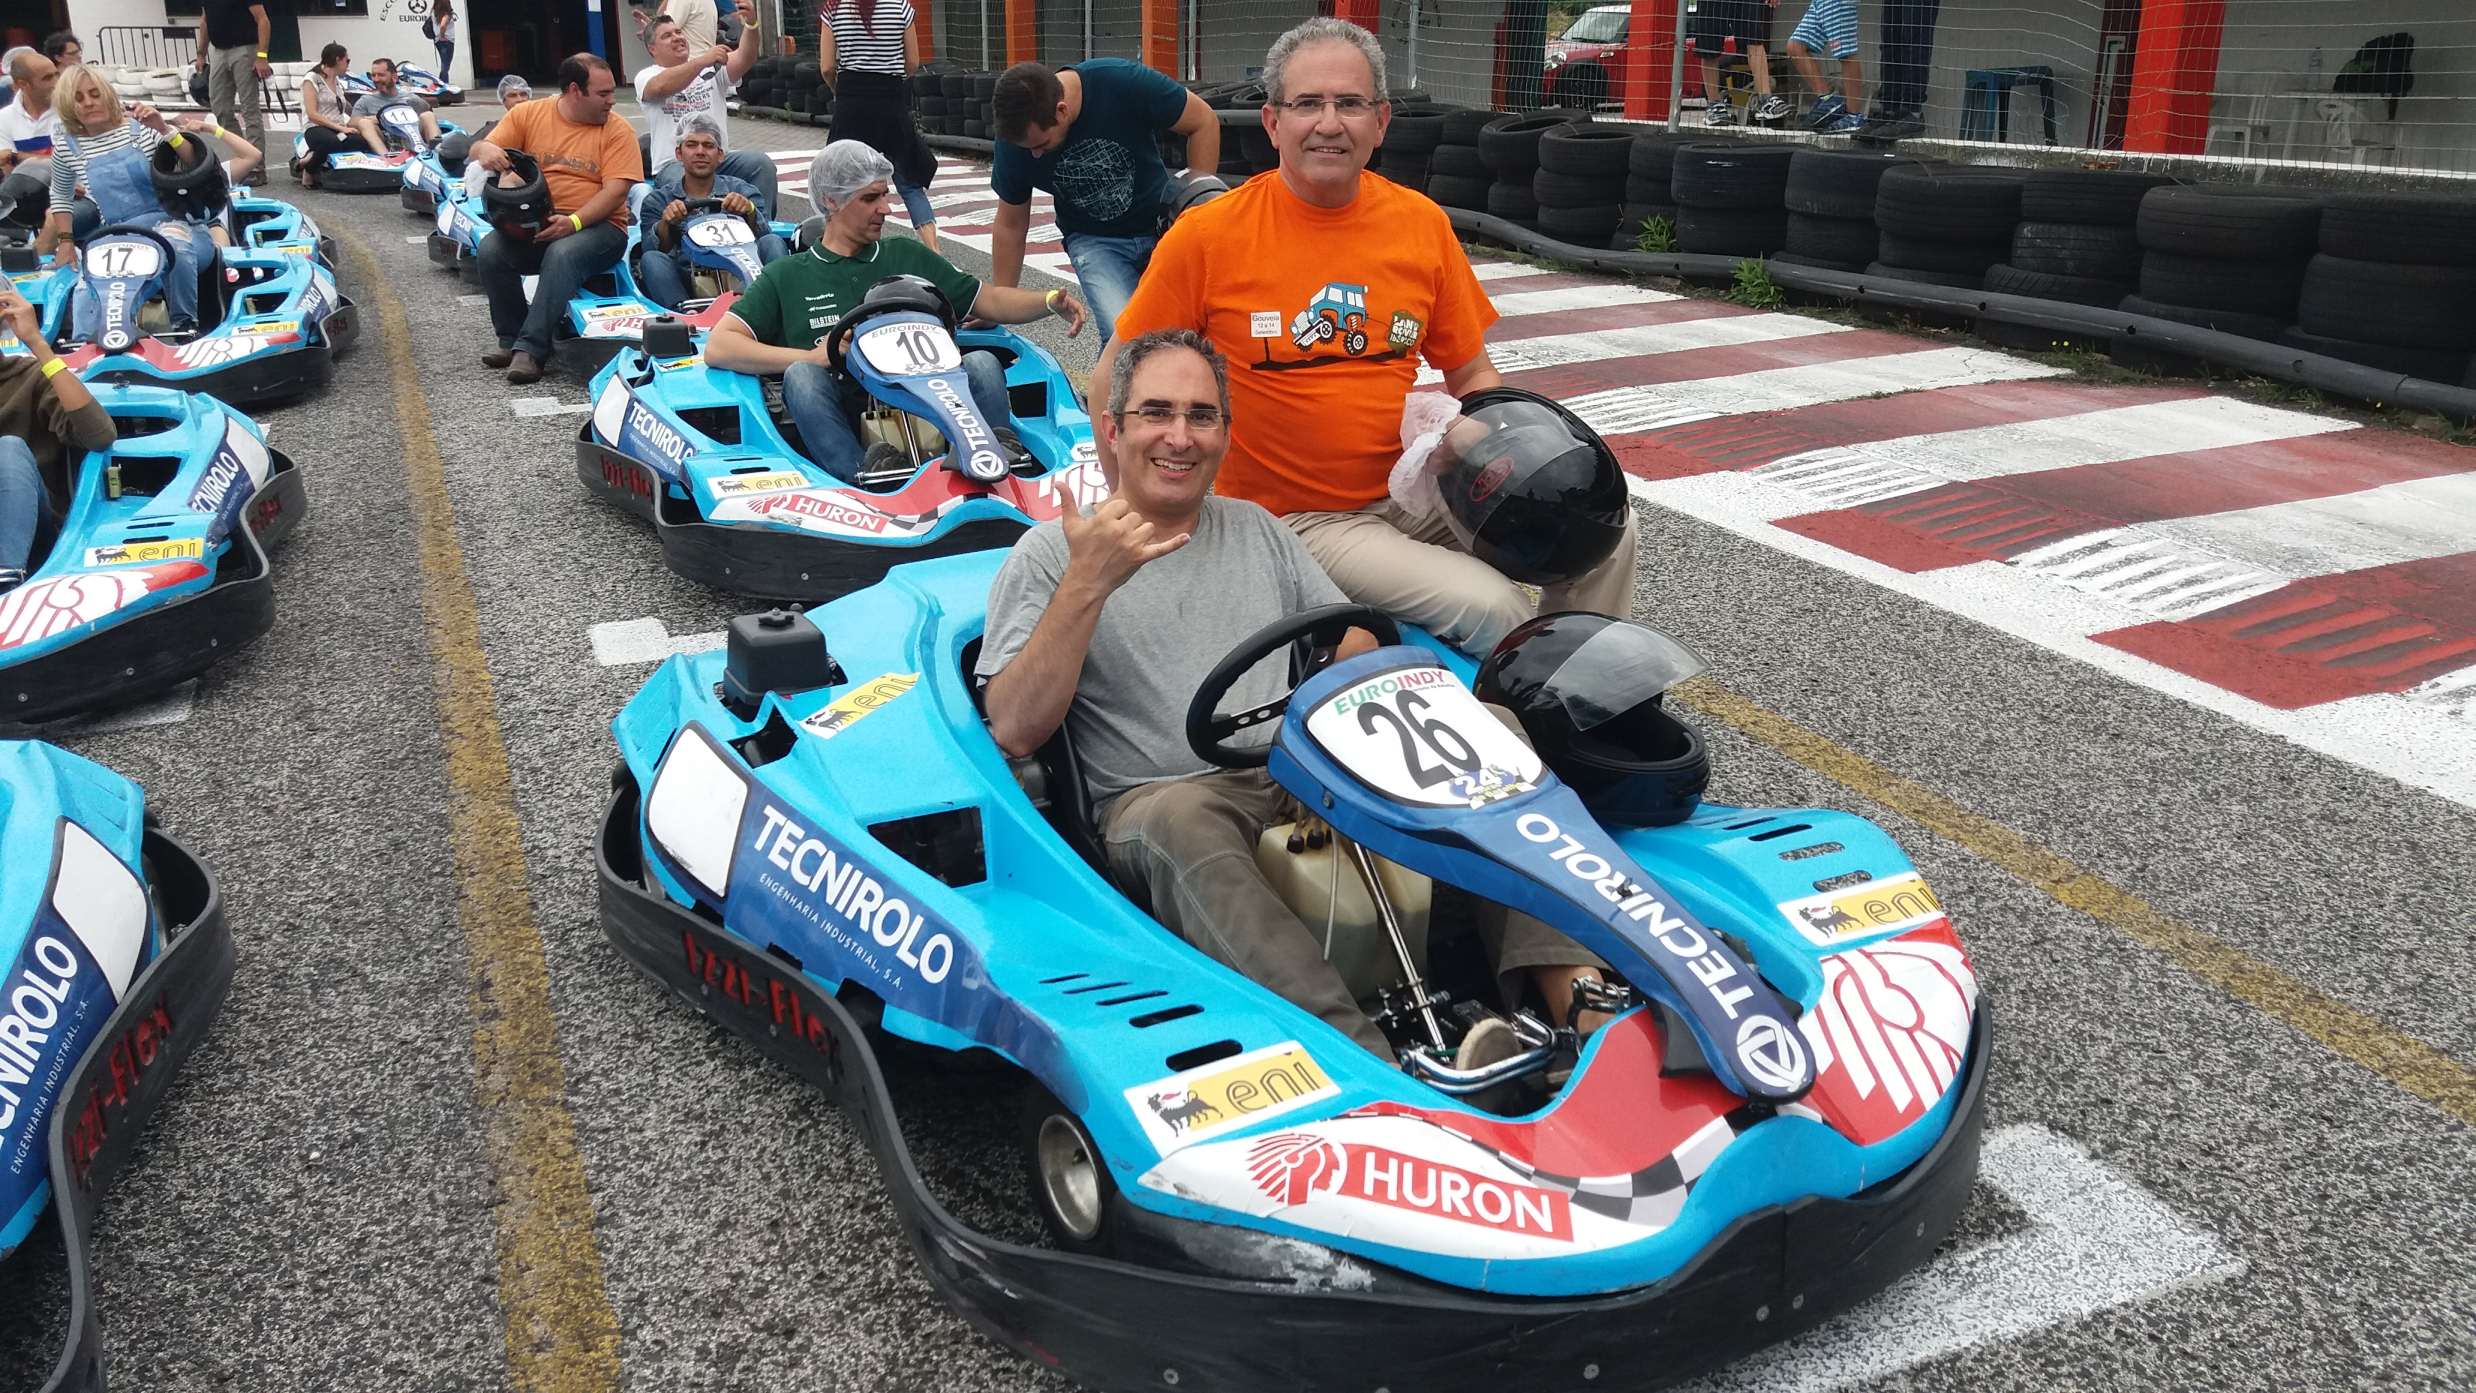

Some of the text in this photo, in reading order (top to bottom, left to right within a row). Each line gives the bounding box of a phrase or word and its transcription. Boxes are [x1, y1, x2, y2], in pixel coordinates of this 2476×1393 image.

[706, 223, 738, 242] 31
[102, 248, 133, 273] 17
[871, 324, 937, 338] EUROINDY
[896, 331, 940, 365] 10
[928, 379, 989, 451] TECNIROLO
[755, 474, 800, 490] eni
[794, 497, 881, 530] HURON
[139, 538, 196, 561] eni
[853, 675, 916, 709] eni
[1333, 670, 1445, 716] EUROINDY
[1357, 689, 1481, 789] 26
[754, 804, 953, 984] TECNIROLO
[1515, 812, 1754, 1020] TECNIROLO
[1864, 879, 1942, 925] eni
[759, 872, 819, 924] ENGENHARIA
[820, 920, 880, 974] INDUSTRIAL,
[1225, 1051, 1321, 1114] eni
[11, 1096, 49, 1175] ENGENHARIA
[1364, 1151, 1553, 1233] HURON
